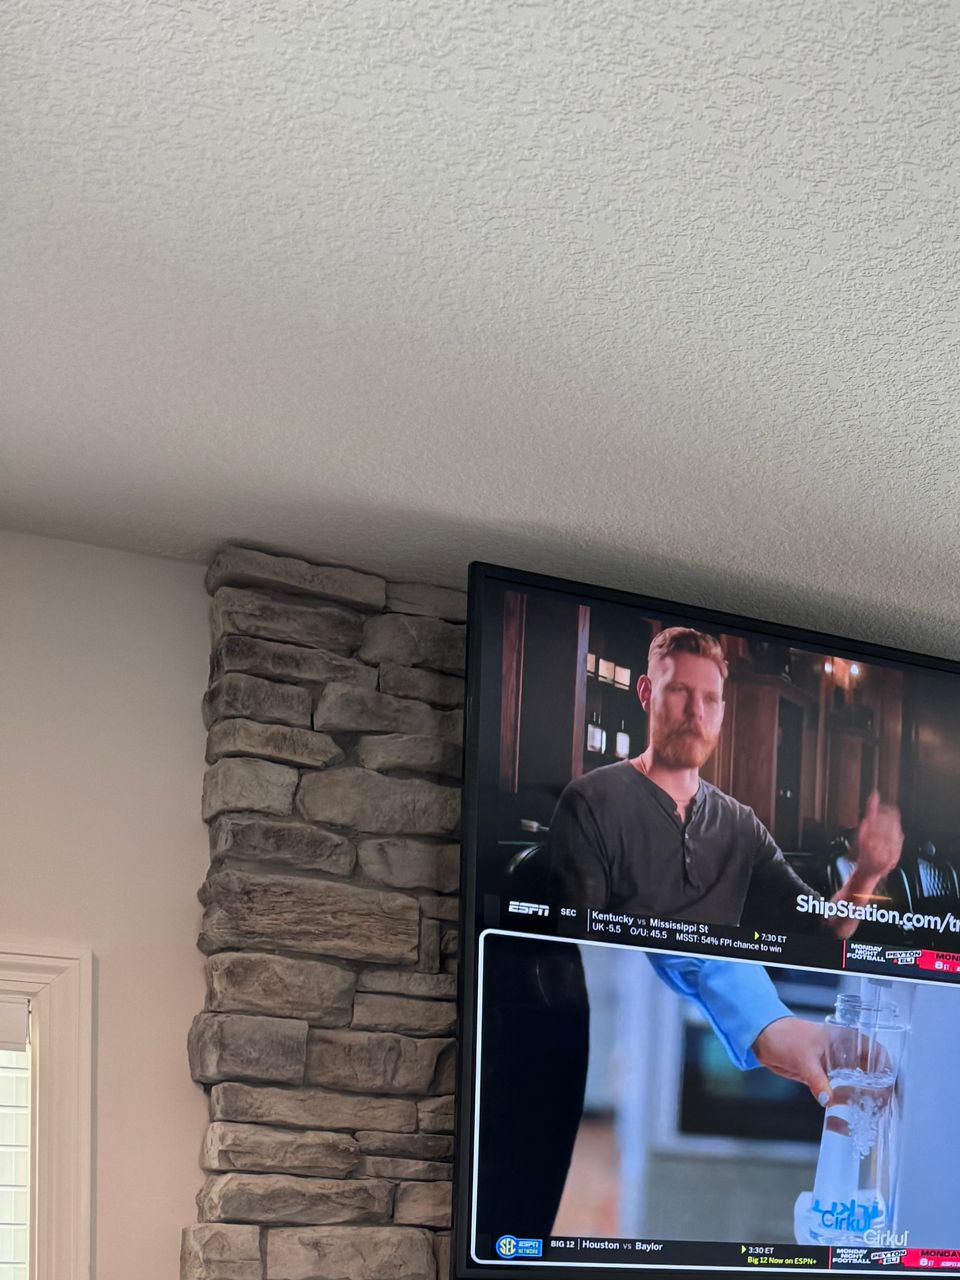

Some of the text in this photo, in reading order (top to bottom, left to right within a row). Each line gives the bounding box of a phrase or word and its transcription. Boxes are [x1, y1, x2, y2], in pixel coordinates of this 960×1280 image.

[508, 900, 549, 917] ESPN
[560, 908, 577, 917] SEC
[592, 911, 709, 934] Kentucky vs Mississippi St
[592, 922, 782, 953] UK -5.5 O/U: 45.5 MSST: 54% FPI chance to win
[761, 933, 776, 942] 7:30
[935, 961, 943, 969] 8
[863, 1228, 909, 1247] Cirkul
[500, 1238, 517, 1256] SEC
[551, 1240, 565, 1248] BIG
[566, 1240, 575, 1248] 12
[582, 1240, 620, 1250] Houston
[635, 1242, 663, 1252] Baylor
[748, 1246, 763, 1255] 3:30
[747, 1255, 758, 1266] Big
[768, 1257, 784, 1265] Now
[794, 1257, 817, 1266] ESPN+
